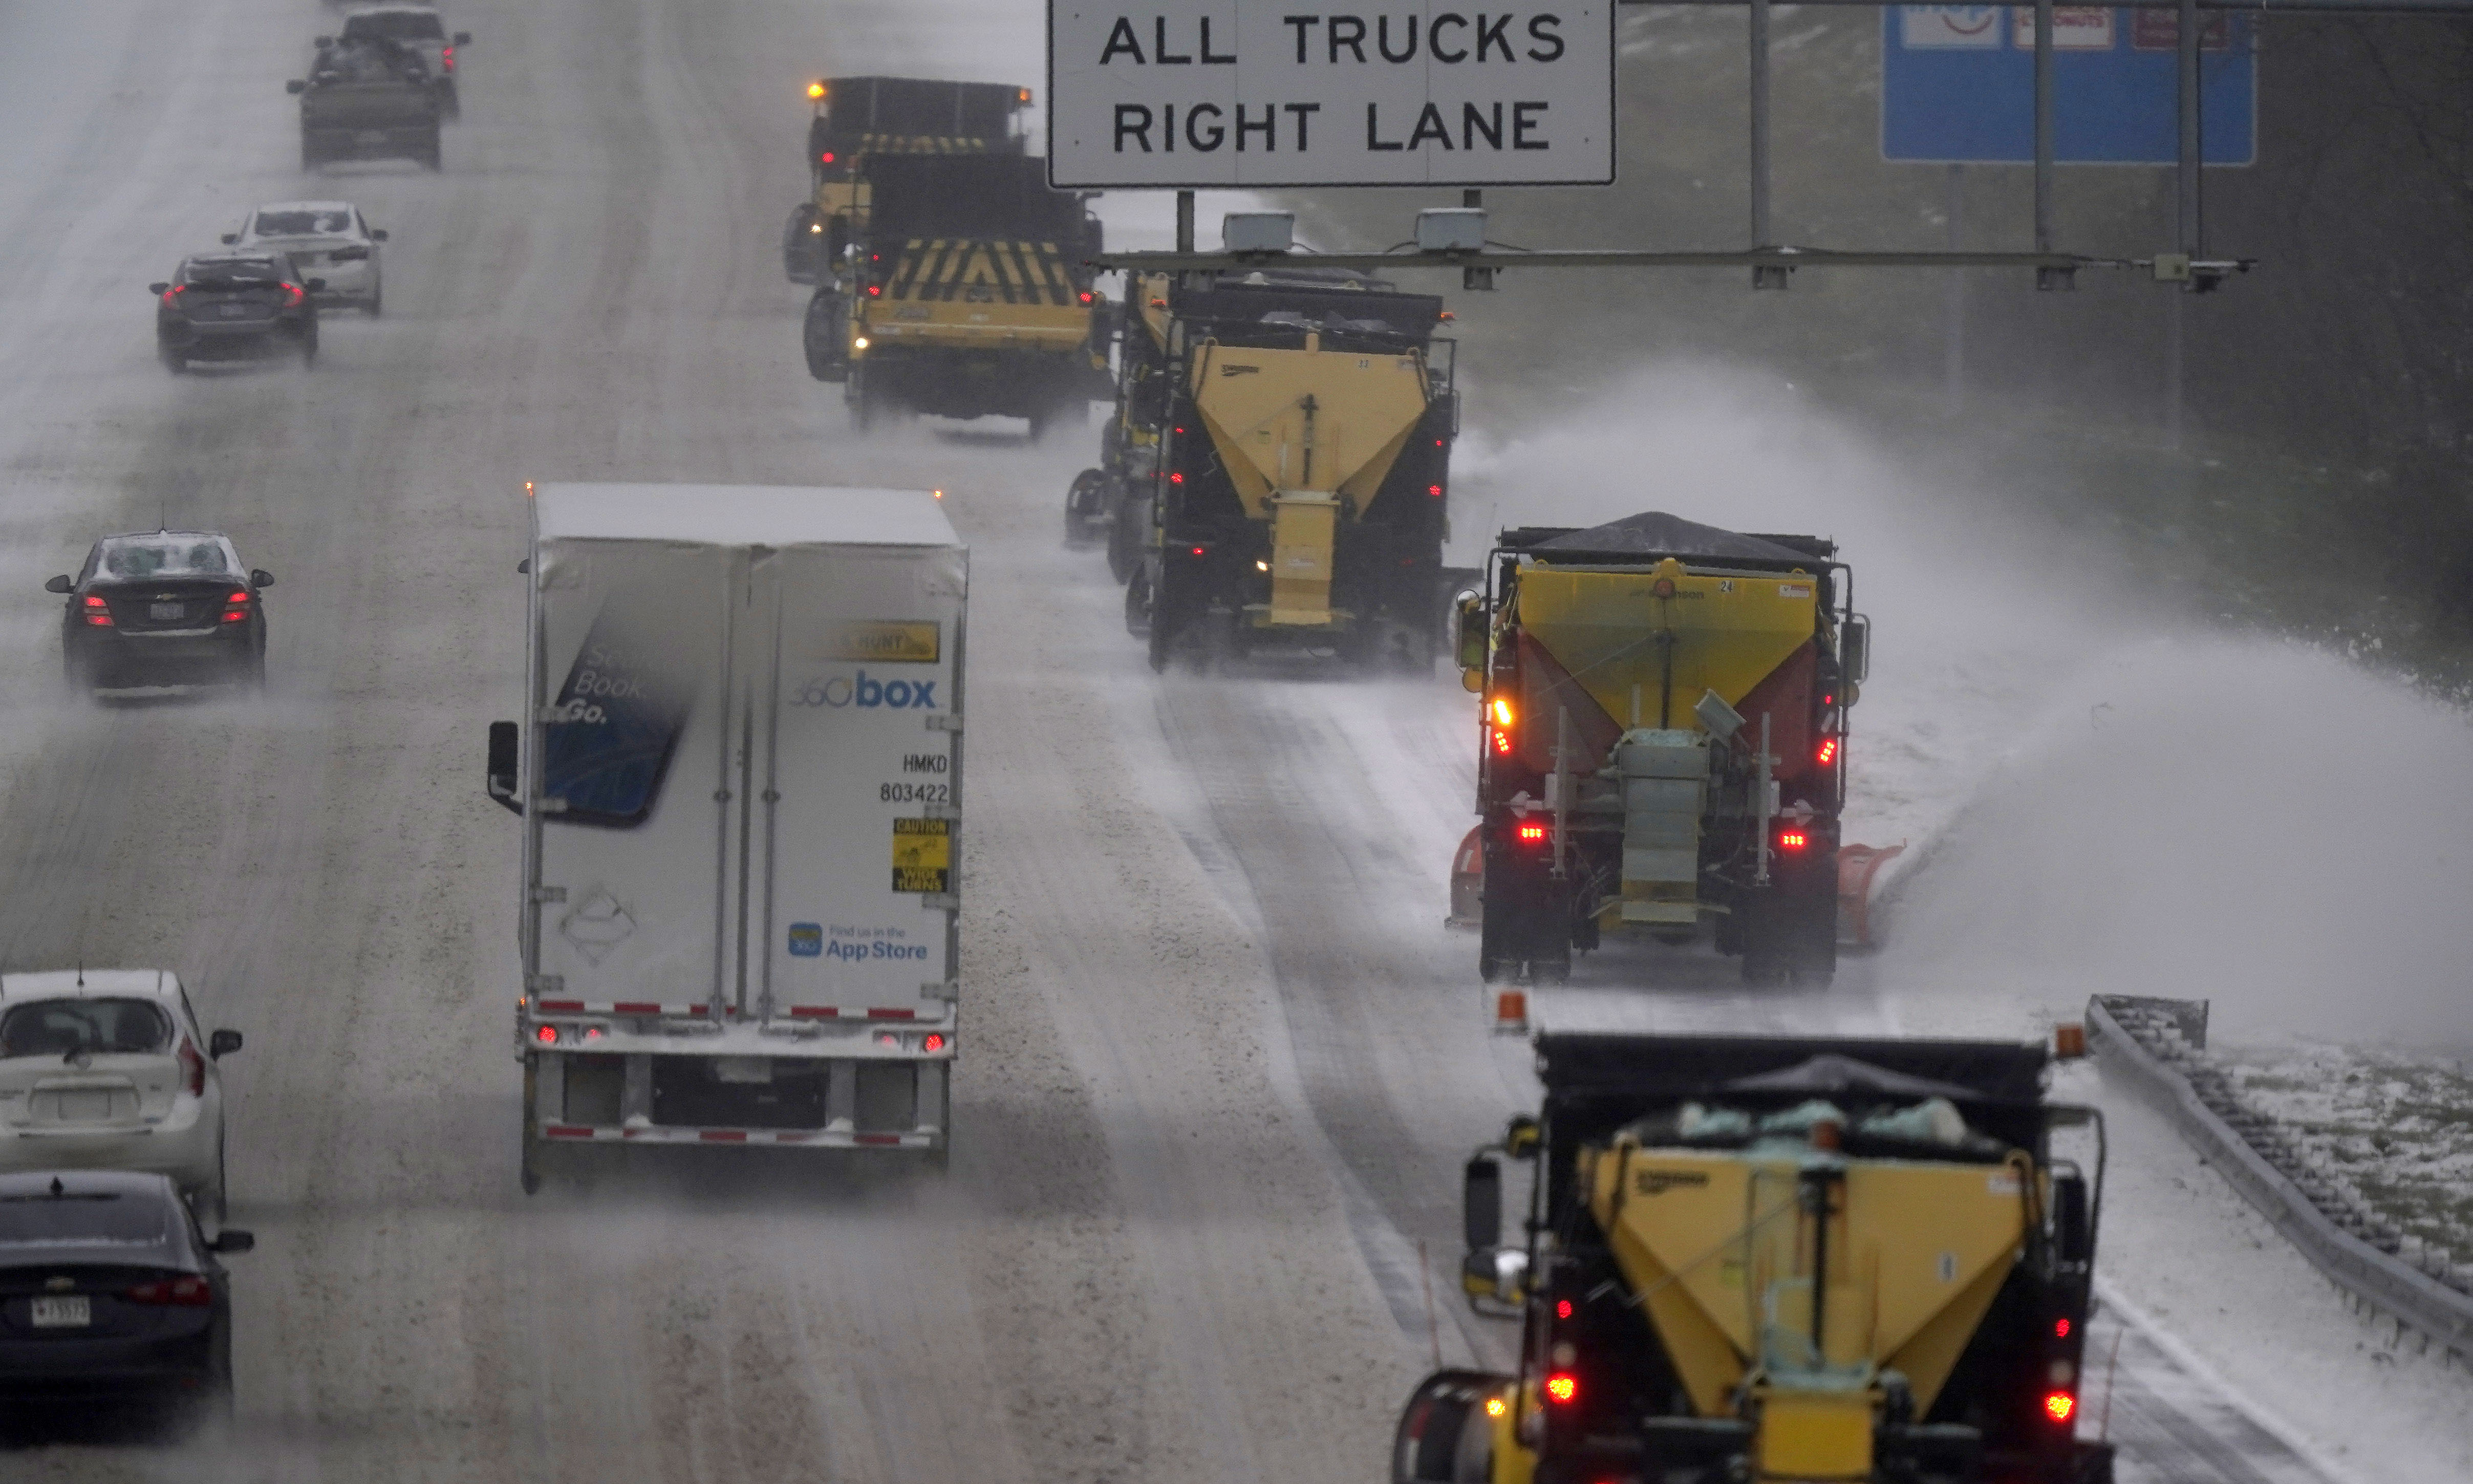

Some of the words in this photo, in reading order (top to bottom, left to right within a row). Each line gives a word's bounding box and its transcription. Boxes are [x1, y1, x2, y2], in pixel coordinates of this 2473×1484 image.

[1100, 16, 1236, 64] ALL
[1284, 14, 1565, 63] TRUCKS
[1114, 103, 1320, 152] RIGHT
[1367, 102, 1550, 150] LANE
[1721, 581, 1732, 592] 24
[564, 698, 607, 724] Go.
[904, 754, 947, 773] HMKD
[880, 783, 948, 802] 803422
[829, 926, 853, 937] Find
[857, 928, 870, 938] us
[873, 927, 884, 937] in
[887, 928, 905, 939] the
[827, 940, 868, 961] App
[872, 941, 927, 960] Store
